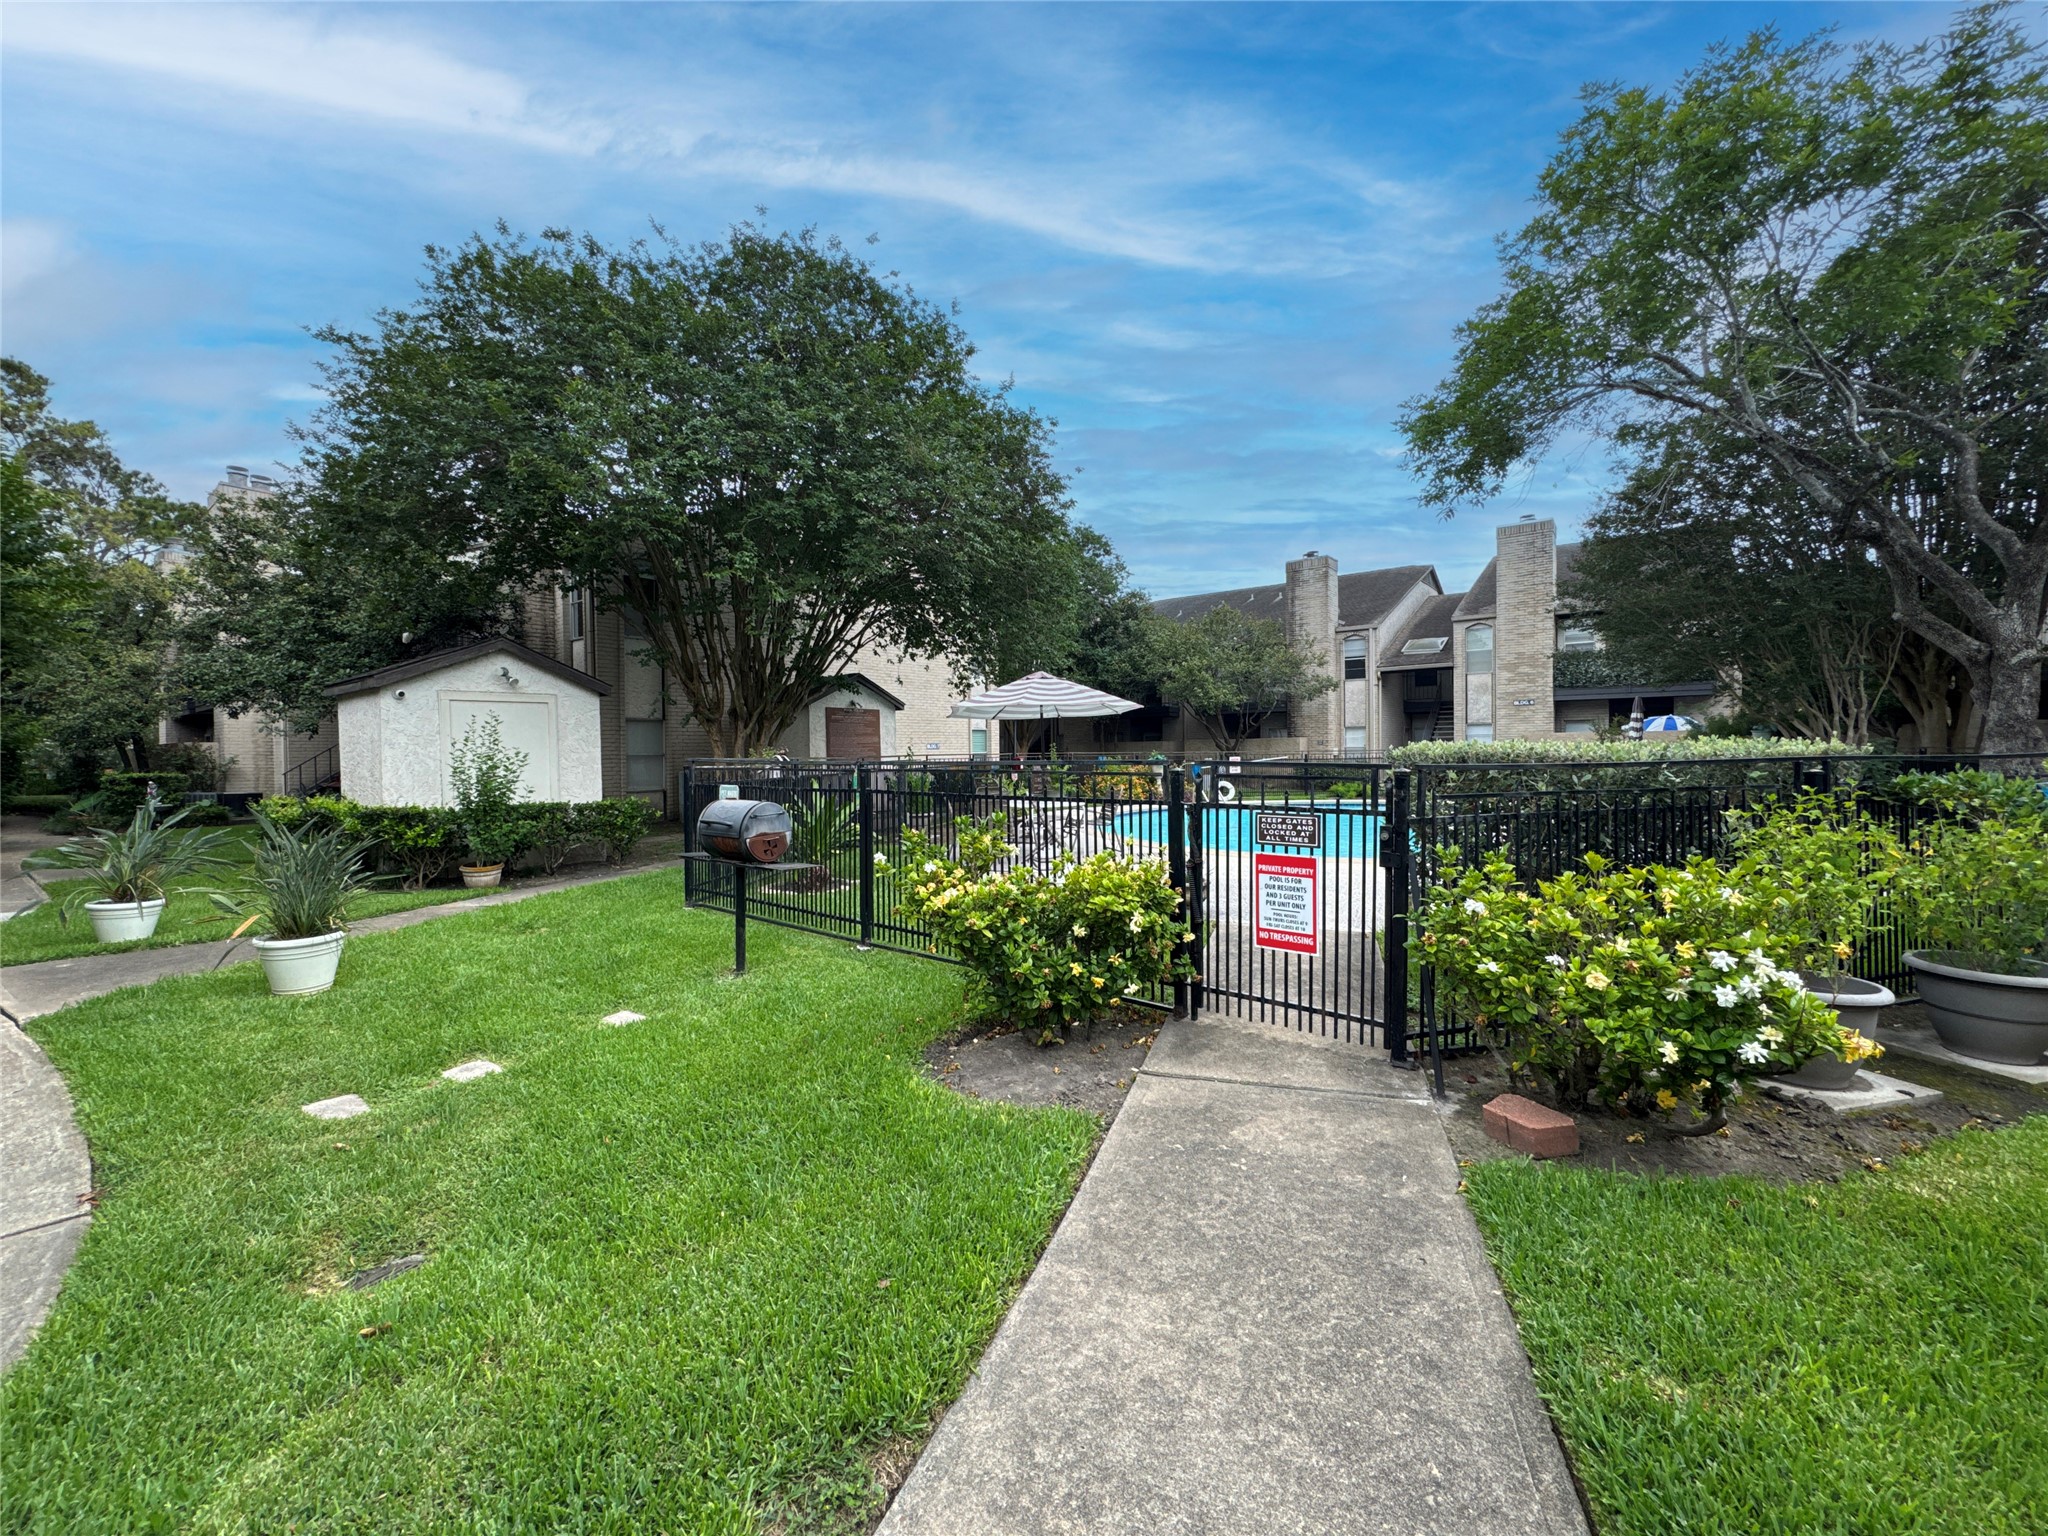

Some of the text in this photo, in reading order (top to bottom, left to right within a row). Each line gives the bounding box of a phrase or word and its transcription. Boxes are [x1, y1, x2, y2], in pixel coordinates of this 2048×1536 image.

[1258, 864, 1314, 876] PRIVATE PROPERTY
[1277, 885, 1307, 894] RESIDENTS
[1270, 932, 1314, 946] TRESPASSING
